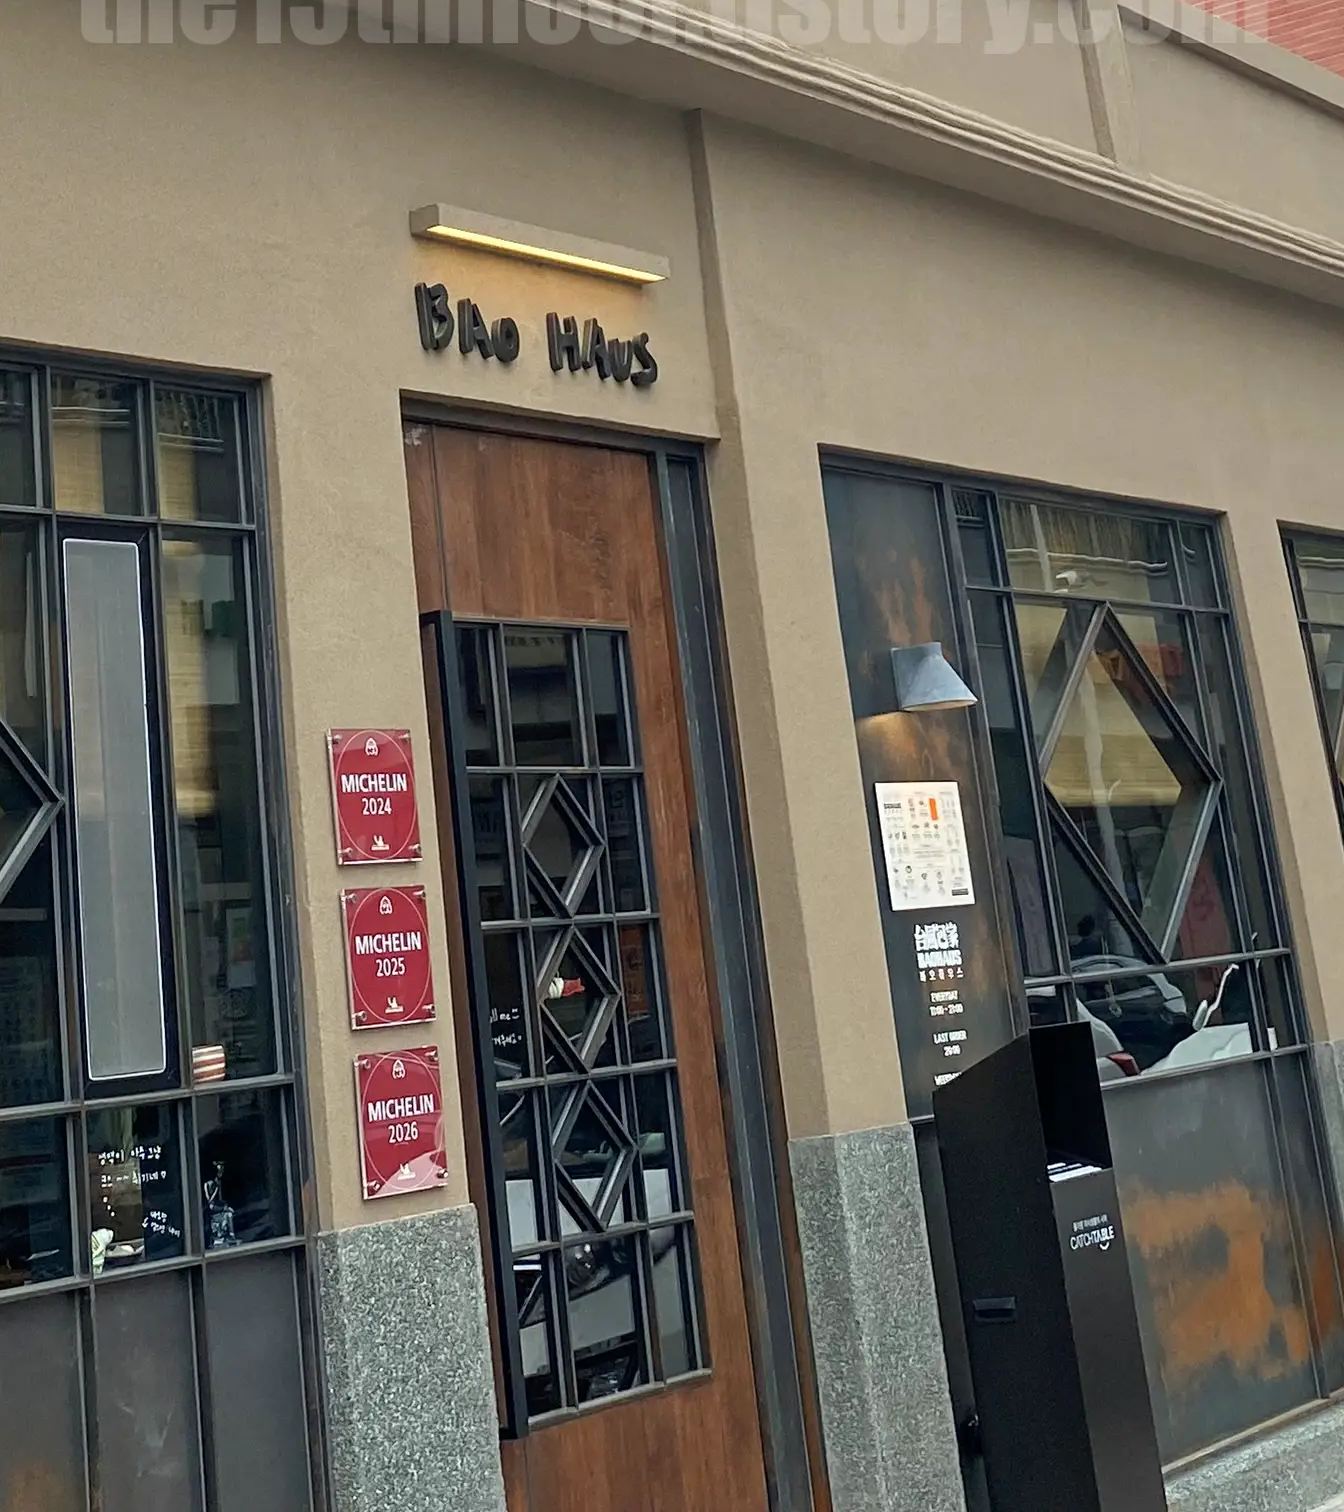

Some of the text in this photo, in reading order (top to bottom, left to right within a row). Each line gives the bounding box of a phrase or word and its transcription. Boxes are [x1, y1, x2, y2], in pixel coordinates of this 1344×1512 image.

[413, 282, 659, 387] BAO HAUS
[341, 773, 408, 794] MICHELIN
[361, 796, 393, 817] 2024
[355, 931, 423, 955] MICHELIN
[375, 957, 406, 978] 2025
[933, 1032, 949, 1044] LAST
[367, 1094, 435, 1123] MICHELIN
[387, 1122, 419, 1145] 2026
